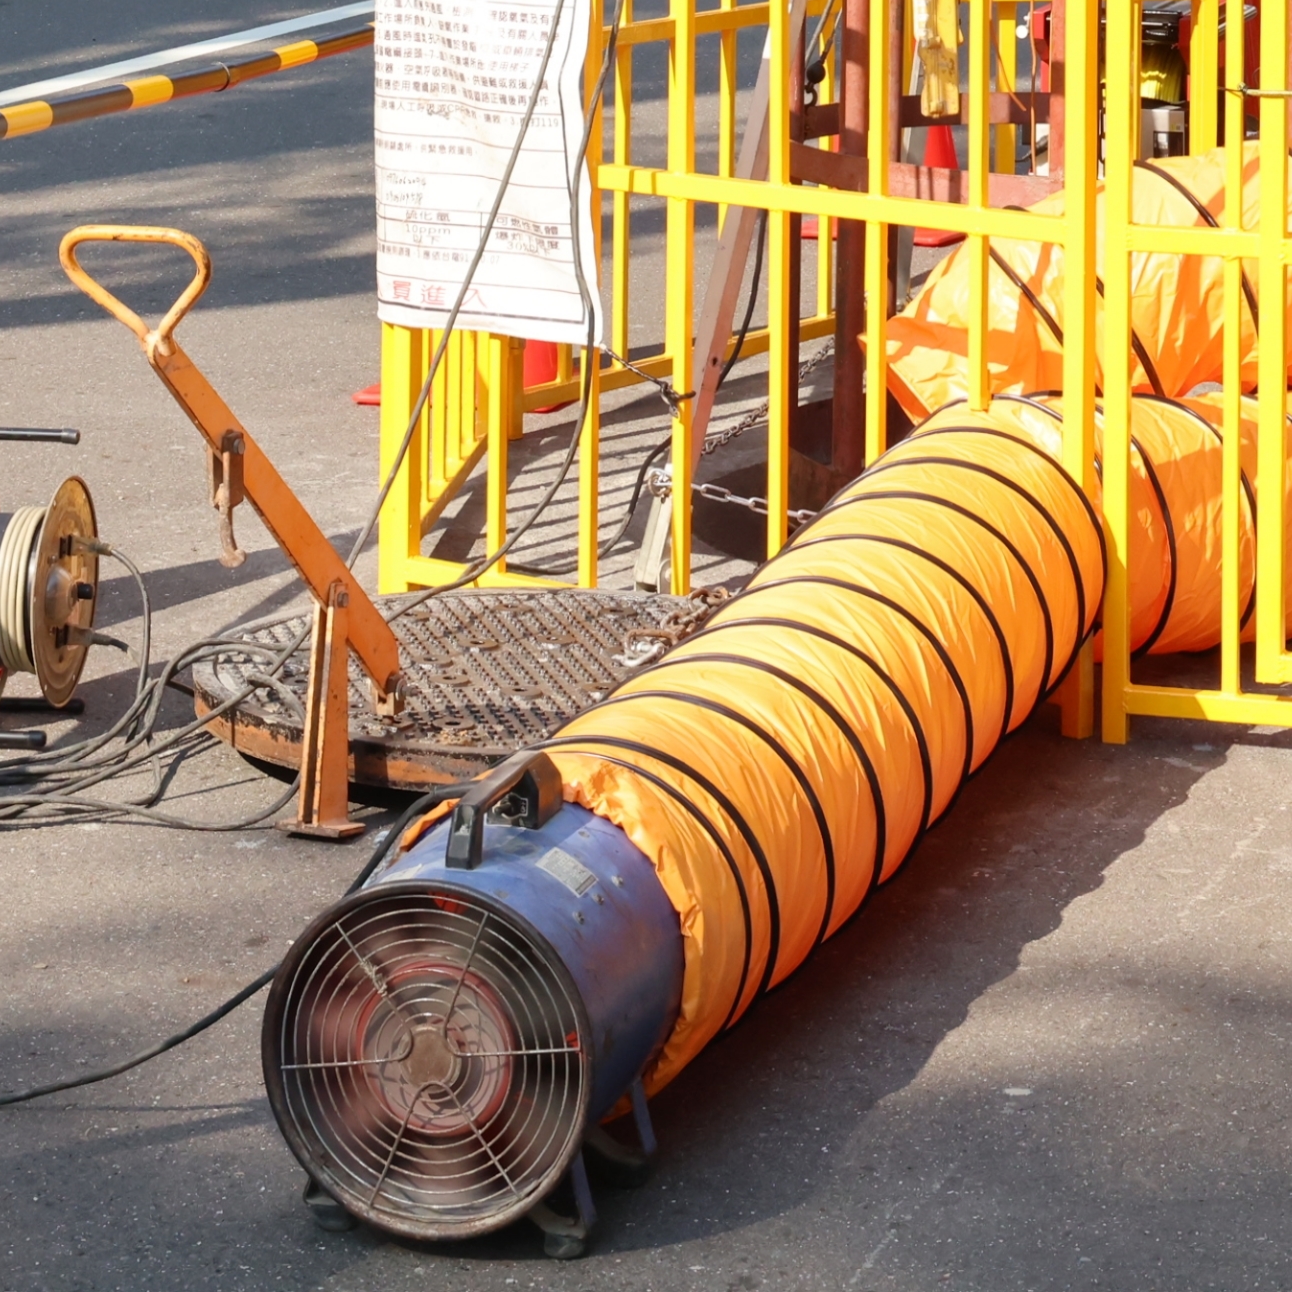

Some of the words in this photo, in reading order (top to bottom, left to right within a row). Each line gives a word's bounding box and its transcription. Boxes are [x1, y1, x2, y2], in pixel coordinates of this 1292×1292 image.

[406, 224, 451, 237] 10ppm
[378, 279, 487, 308] 員進入
